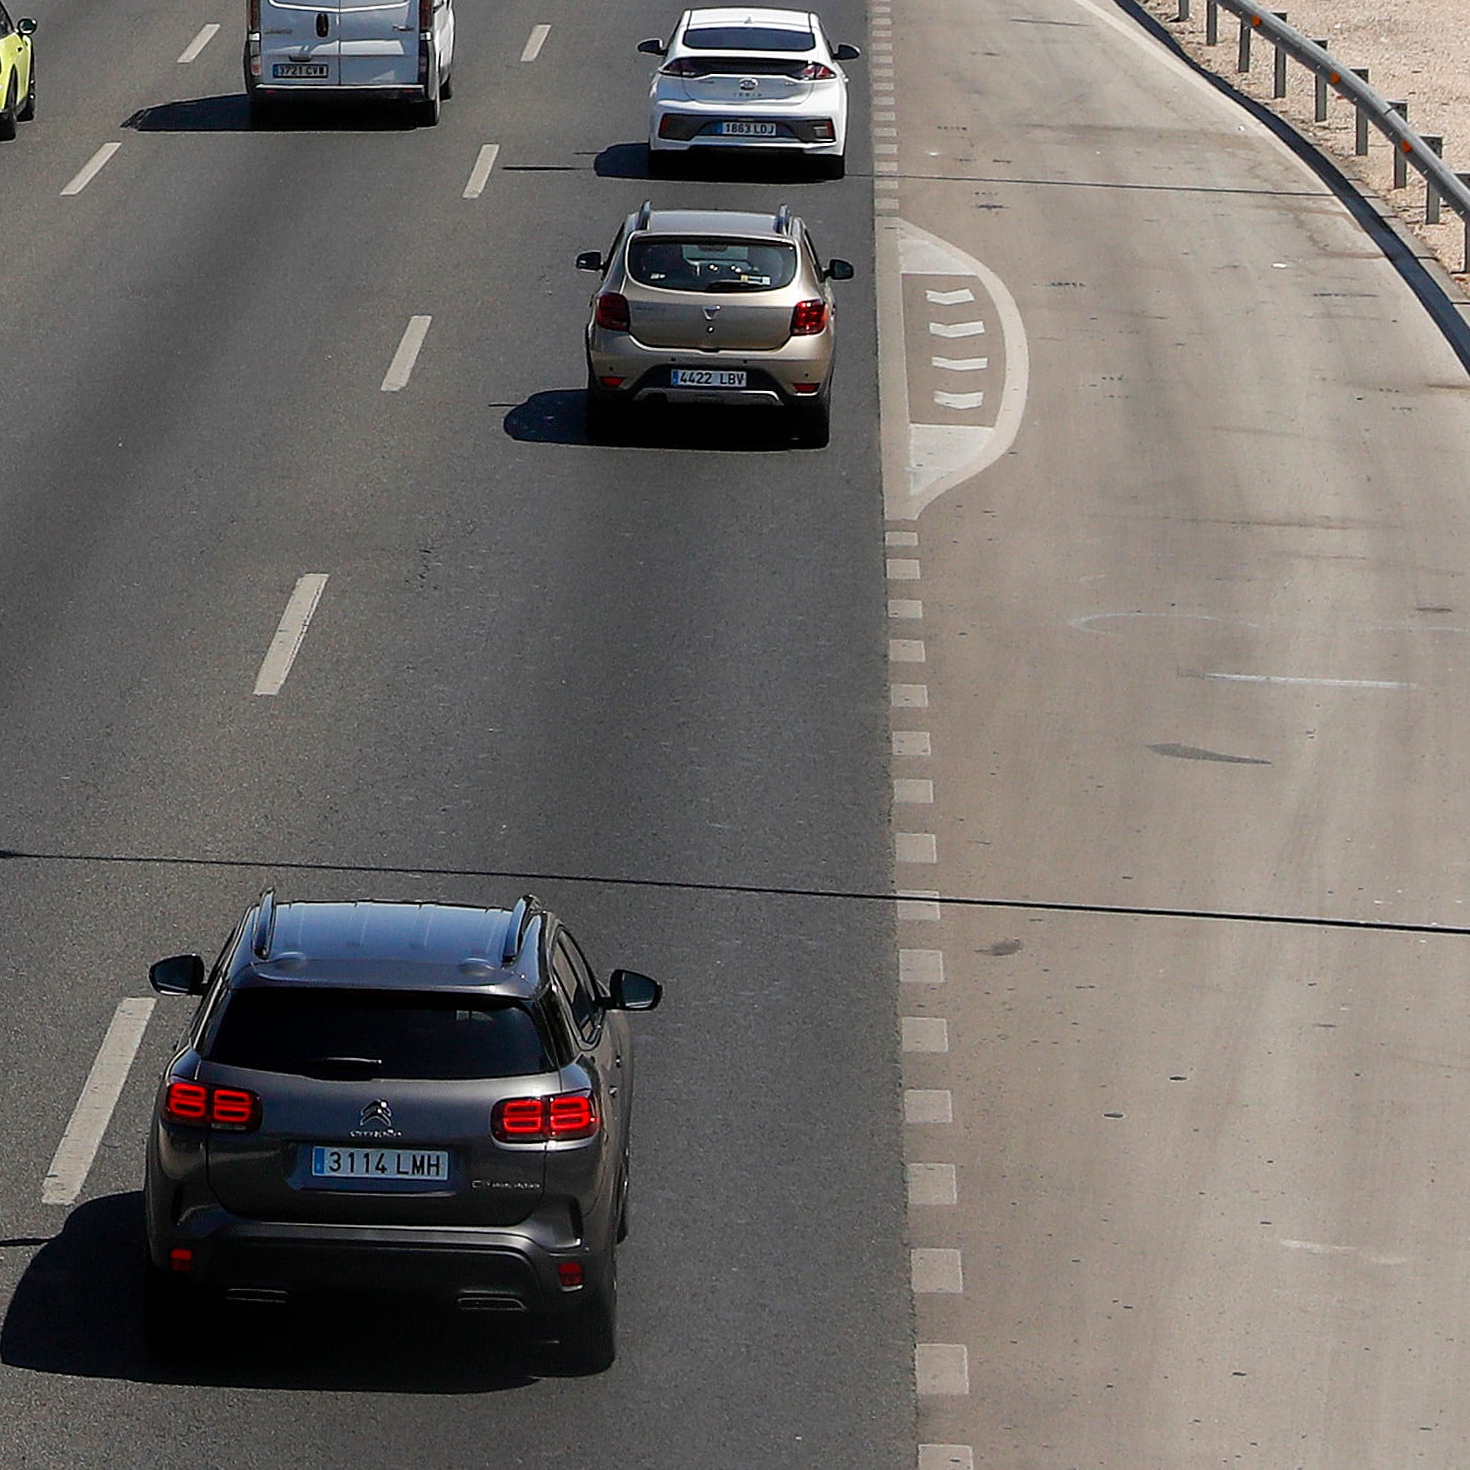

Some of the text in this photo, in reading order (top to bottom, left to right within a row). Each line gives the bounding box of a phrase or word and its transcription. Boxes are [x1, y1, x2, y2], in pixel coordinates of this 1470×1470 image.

[680, 371, 745, 385] 4422 LBV
[329, 1151, 440, 1176] 3114 LMH
